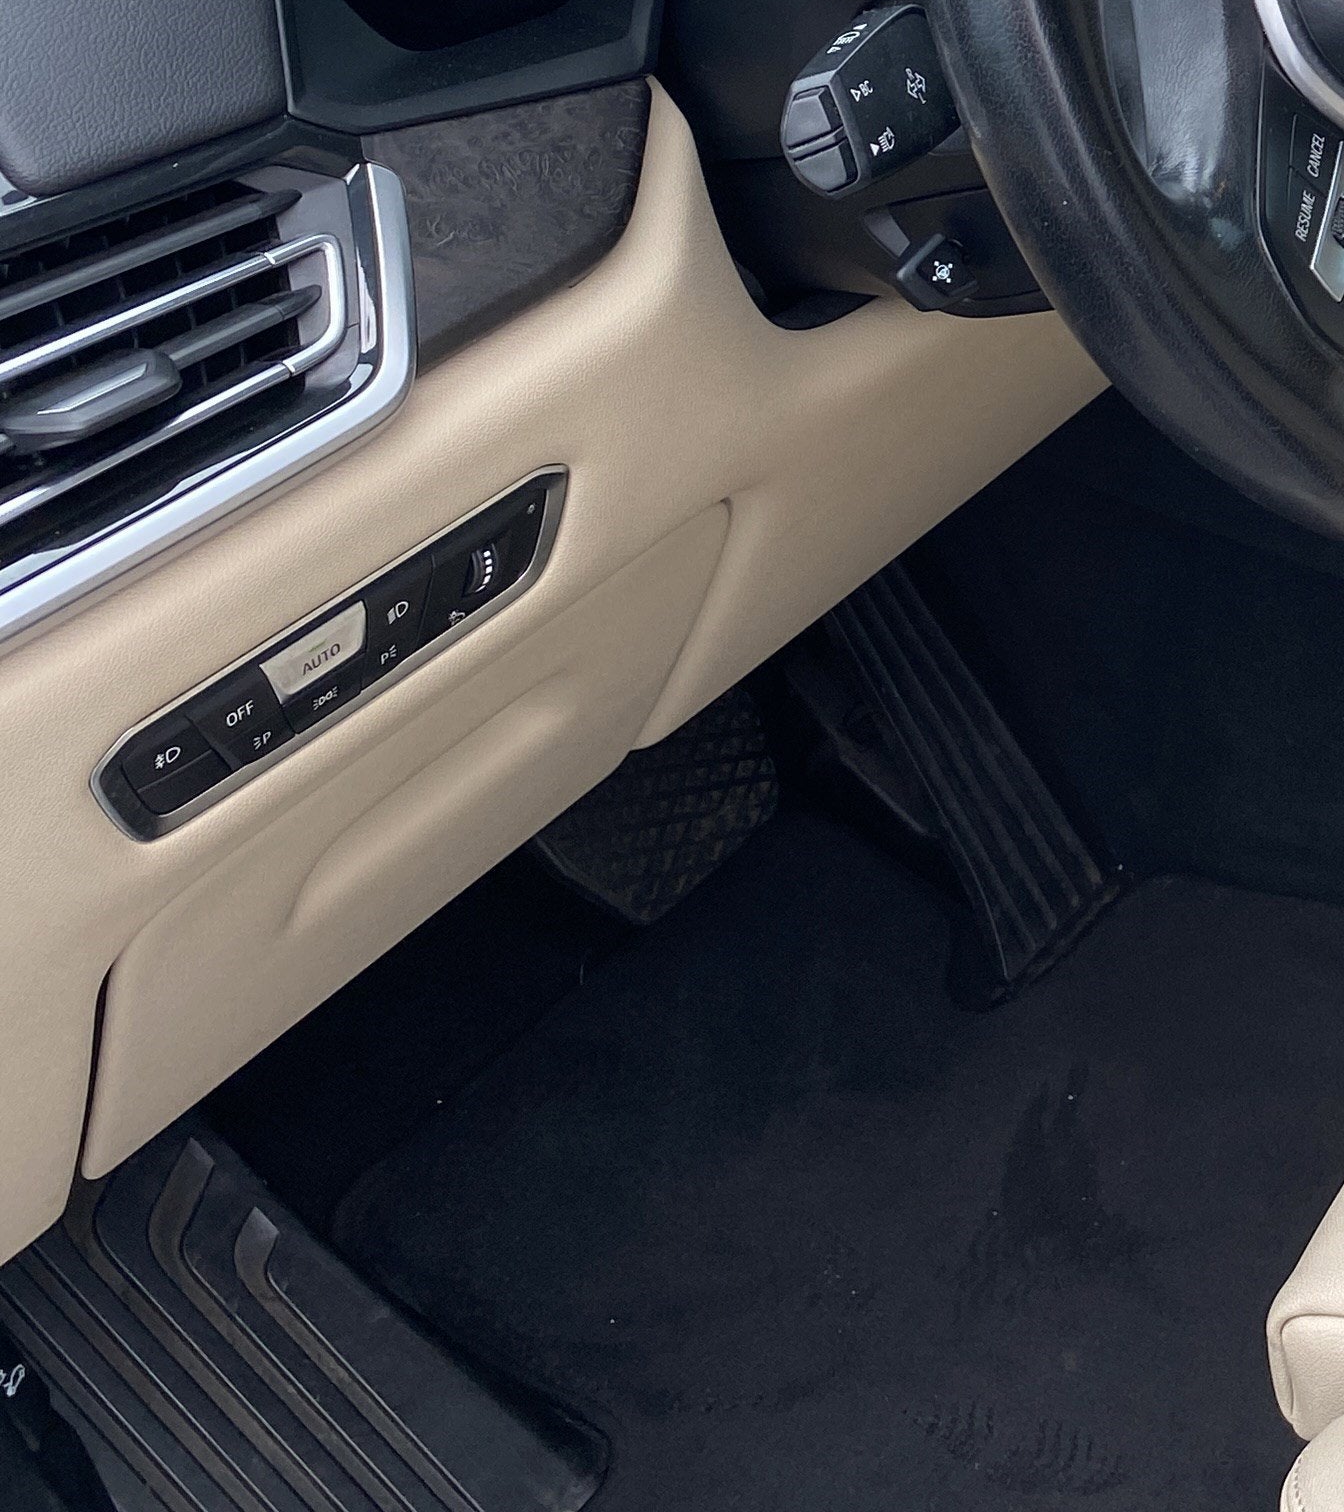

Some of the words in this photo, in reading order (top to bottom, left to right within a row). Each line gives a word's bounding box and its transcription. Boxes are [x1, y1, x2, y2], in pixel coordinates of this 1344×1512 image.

[1306, 133, 1325, 178] CANCEL
[1294, 189, 1316, 242] RESUME
[302, 643, 341, 675] AUTO
[225, 700, 255, 728] OFF
